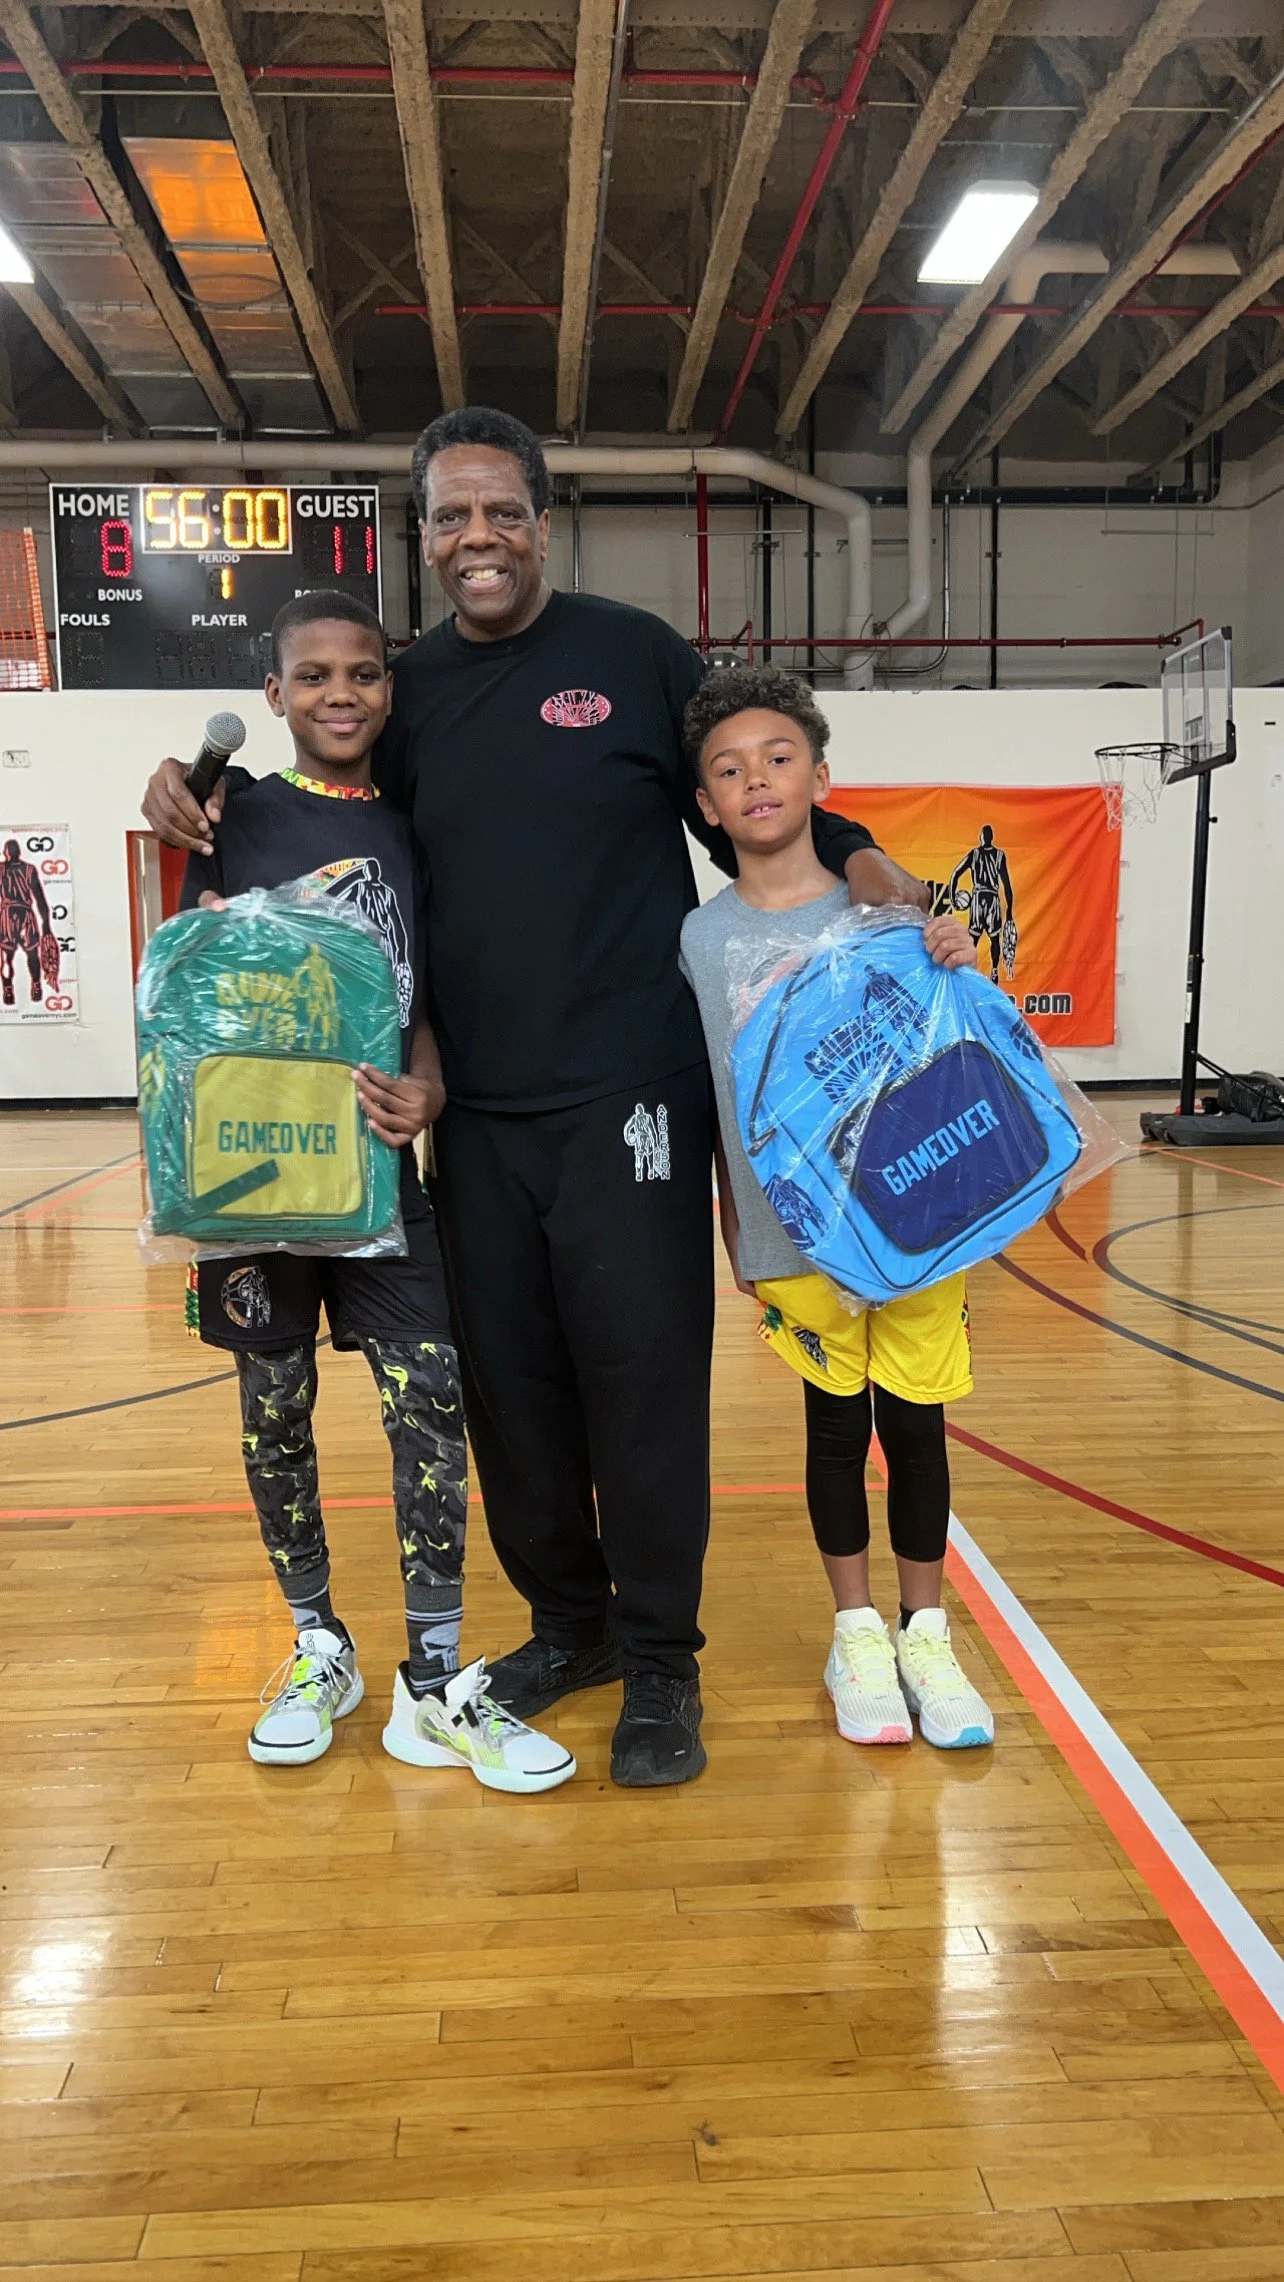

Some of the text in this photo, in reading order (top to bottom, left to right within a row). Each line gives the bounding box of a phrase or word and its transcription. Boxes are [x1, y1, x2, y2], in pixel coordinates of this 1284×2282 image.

[58, 493, 130, 517] HOME
[144, 490, 286, 550] 56:00
[296, 494, 375, 519] GUEST
[100, 520, 133, 578] 8
[197, 553, 241, 565] PERIOD
[333, 525, 374, 575] 11
[97, 588, 143, 602] BONUS
[220, 568, 232, 600] 1
[60, 613, 111, 627] FOULS
[191, 614, 248, 627] PLAYER
[217, 1120, 338, 1155] GAMEOVER
[656, 1103, 671, 1180] ANDERSON
[881, 1099, 1001, 1197] GAMEOVER
